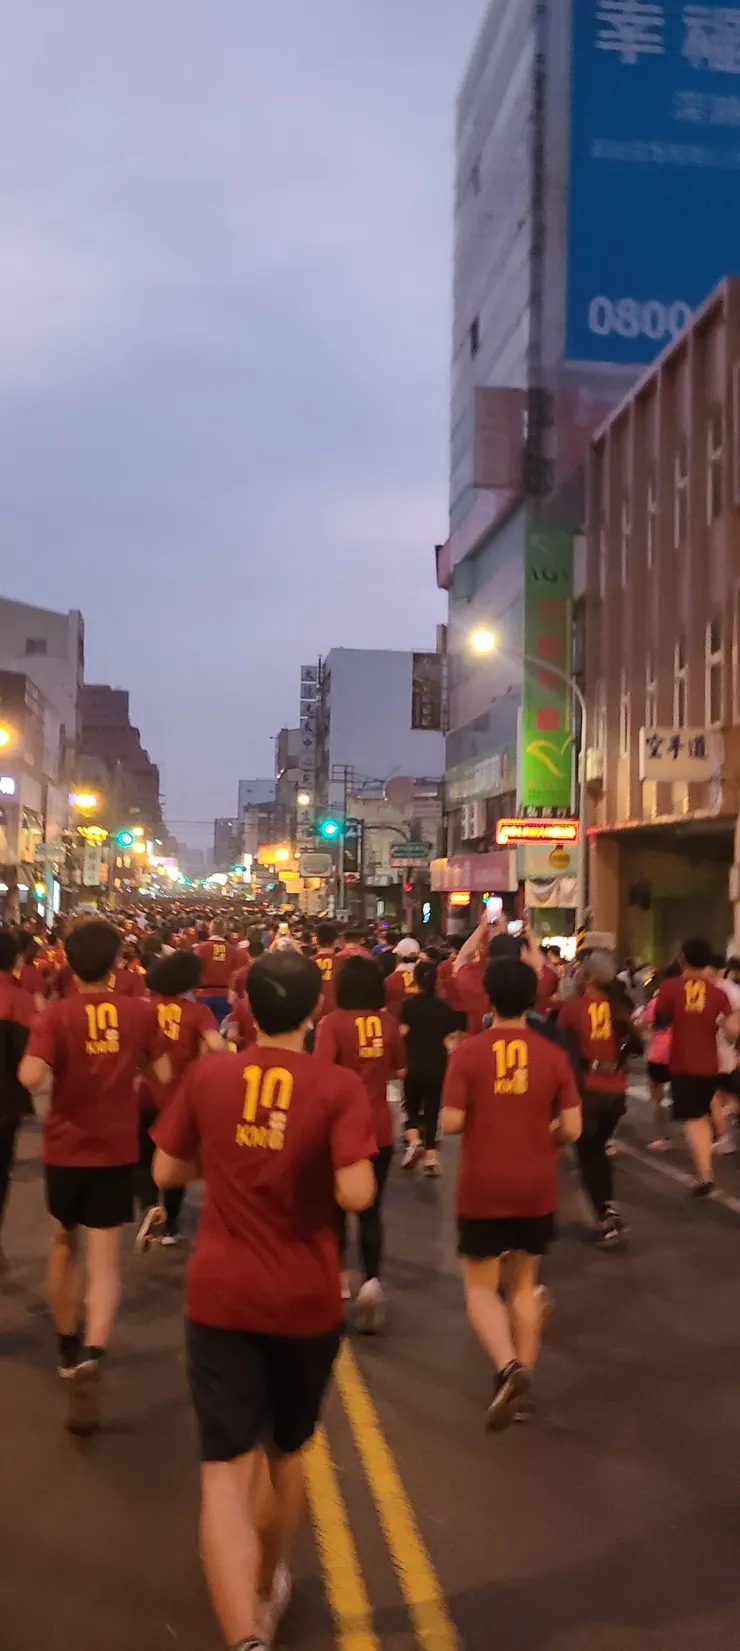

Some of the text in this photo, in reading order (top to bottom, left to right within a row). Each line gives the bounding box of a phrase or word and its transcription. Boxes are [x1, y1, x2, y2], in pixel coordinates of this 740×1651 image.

[588, 295, 691, 341] 0800
[645, 733, 710, 761] 空手道
[85, 1002, 118, 1039] 10
[354, 1015, 382, 1047] 10
[491, 1038, 528, 1077] 10
[242, 1064, 294, 1122] 10
